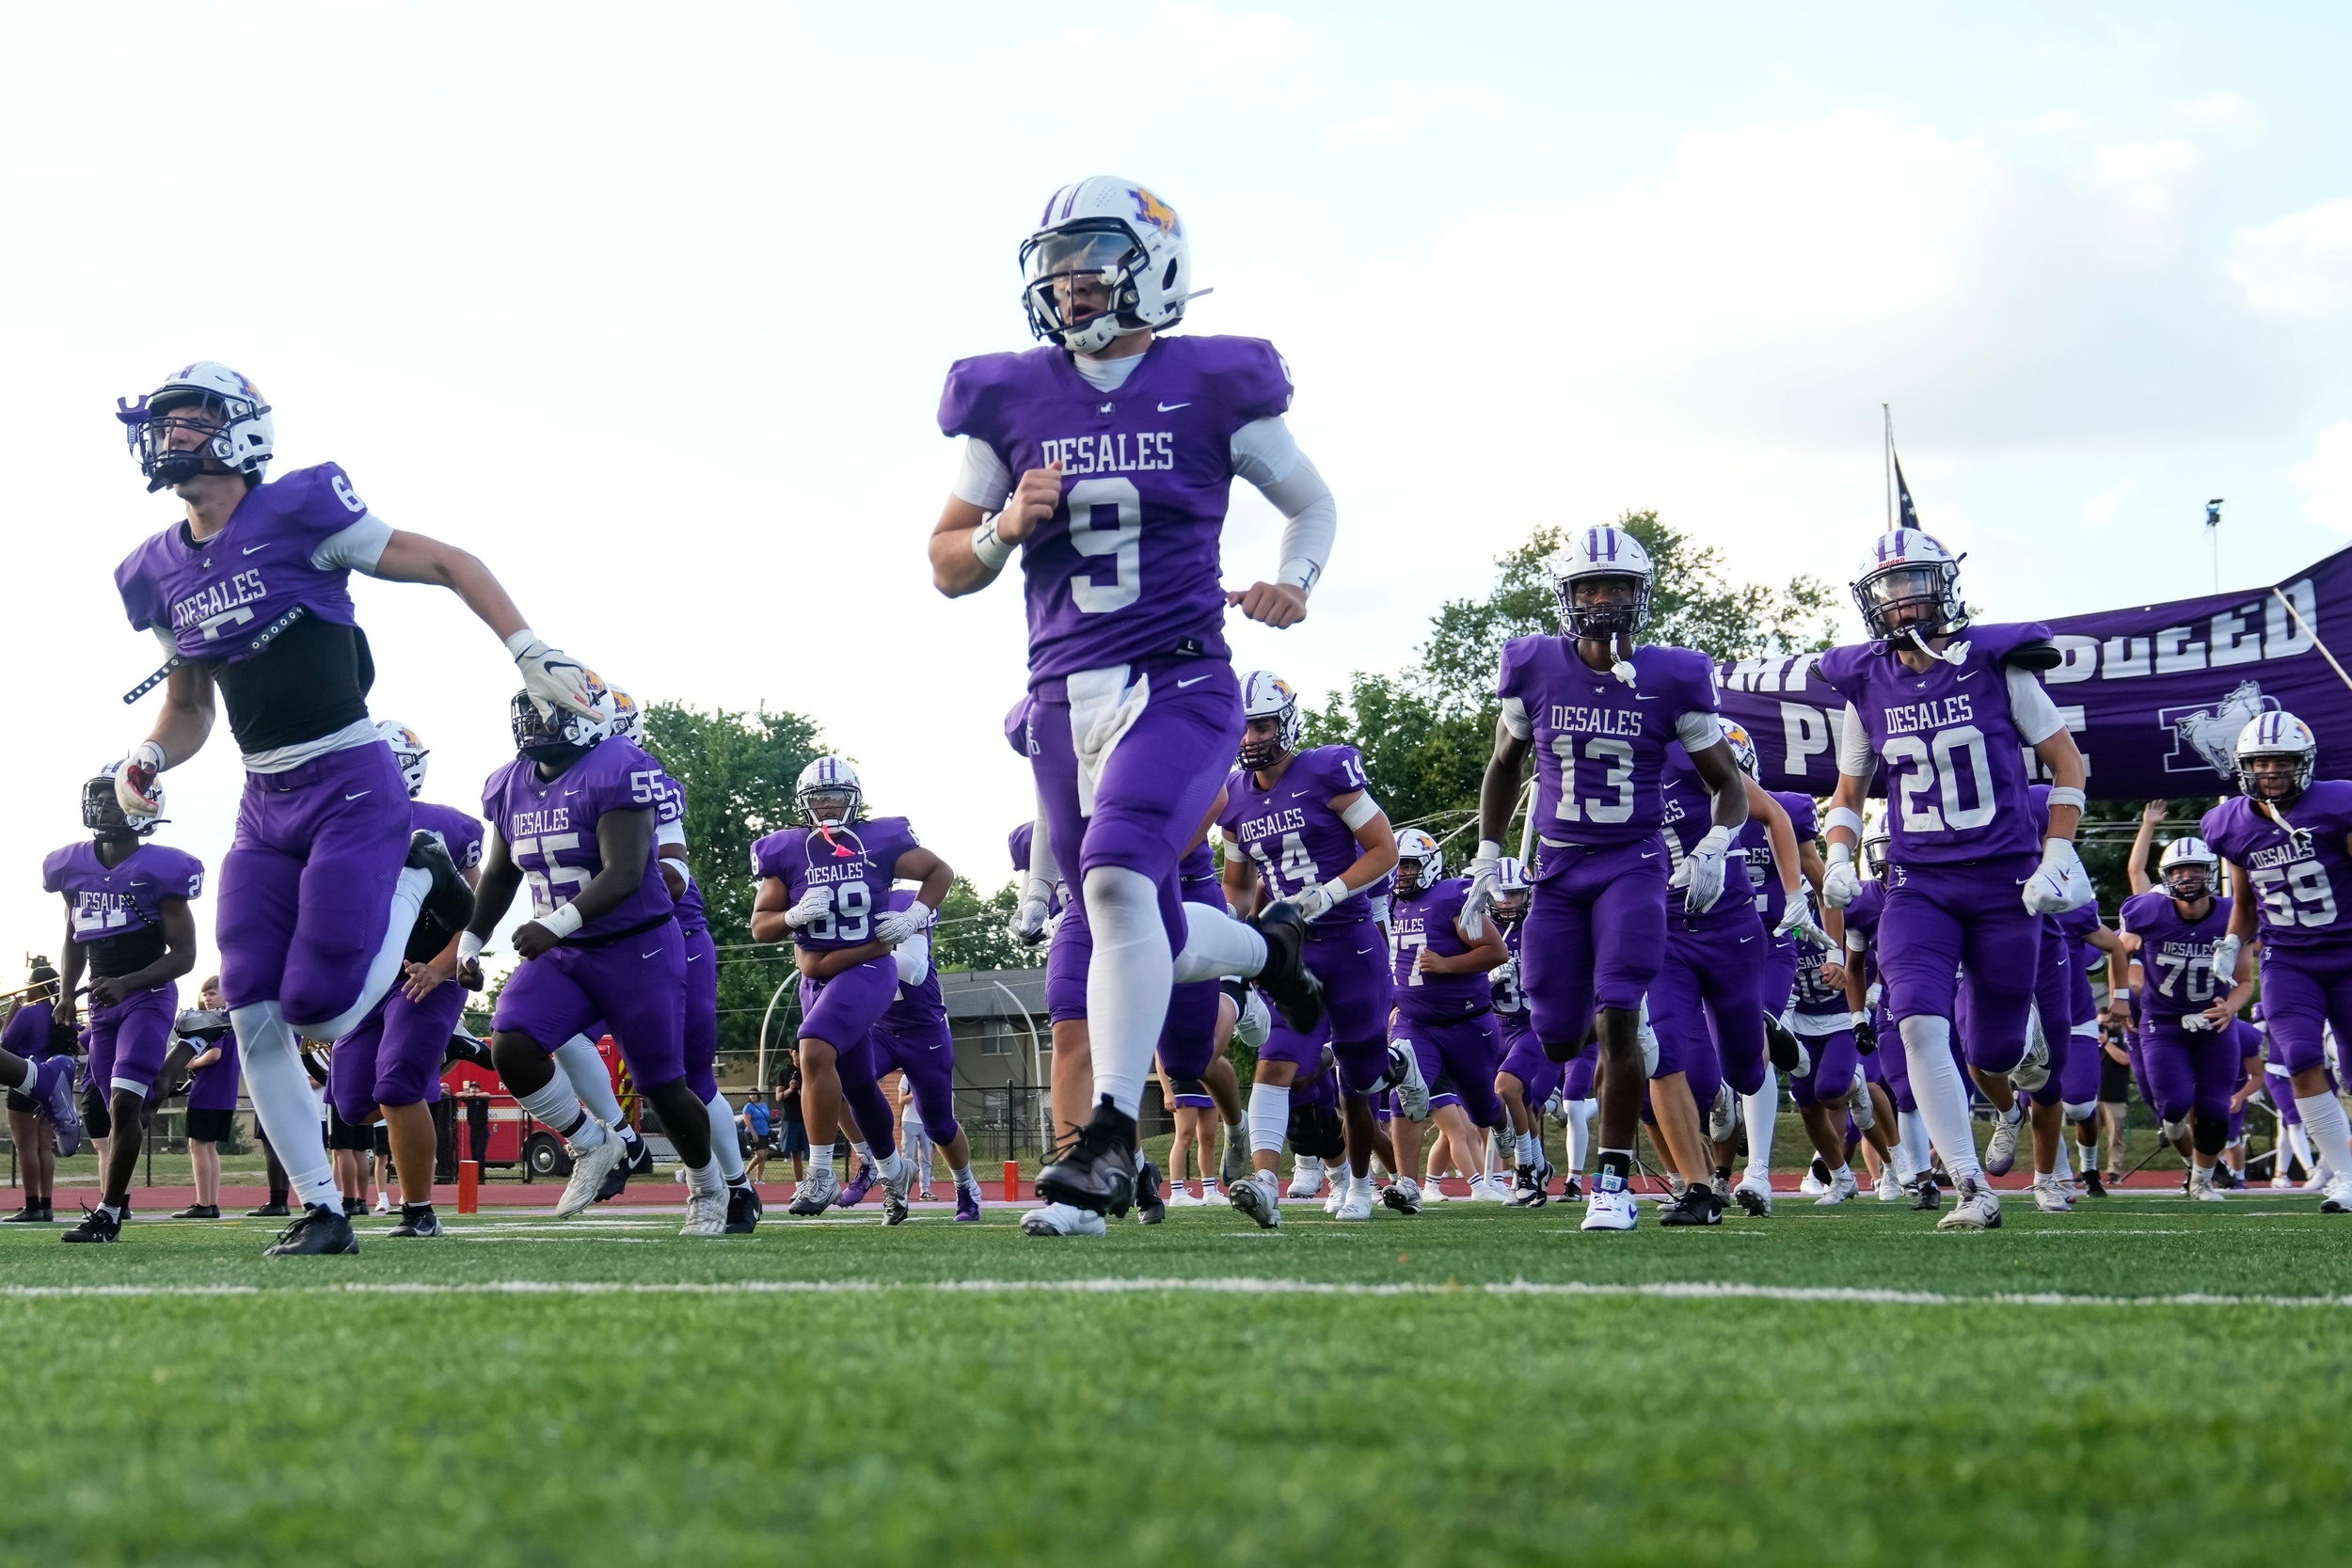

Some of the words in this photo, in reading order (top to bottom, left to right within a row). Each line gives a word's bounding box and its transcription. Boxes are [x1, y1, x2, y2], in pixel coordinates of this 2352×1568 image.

[1041, 432, 1174, 476] DESALES
[332, 475, 365, 513] 6
[1067, 477, 1141, 613] 9
[174, 568, 267, 629] DESALES
[1550, 705, 1643, 736] DESALES
[1883, 694, 1974, 735] DESALES
[630, 769, 666, 803] 55
[1551, 735, 1635, 824] 13
[1882, 725, 1996, 832] 20
[513, 807, 569, 836] DESALES
[1241, 807, 1306, 843] DESALES
[511, 832, 594, 918] 55
[807, 863, 864, 886] DESALES
[1248, 832, 1324, 902] 14
[2249, 843, 2316, 869] DESALES
[2249, 860, 2339, 927] 59
[1496, 967, 1532, 1013] 3
[2155, 953, 2215, 1003] 70
